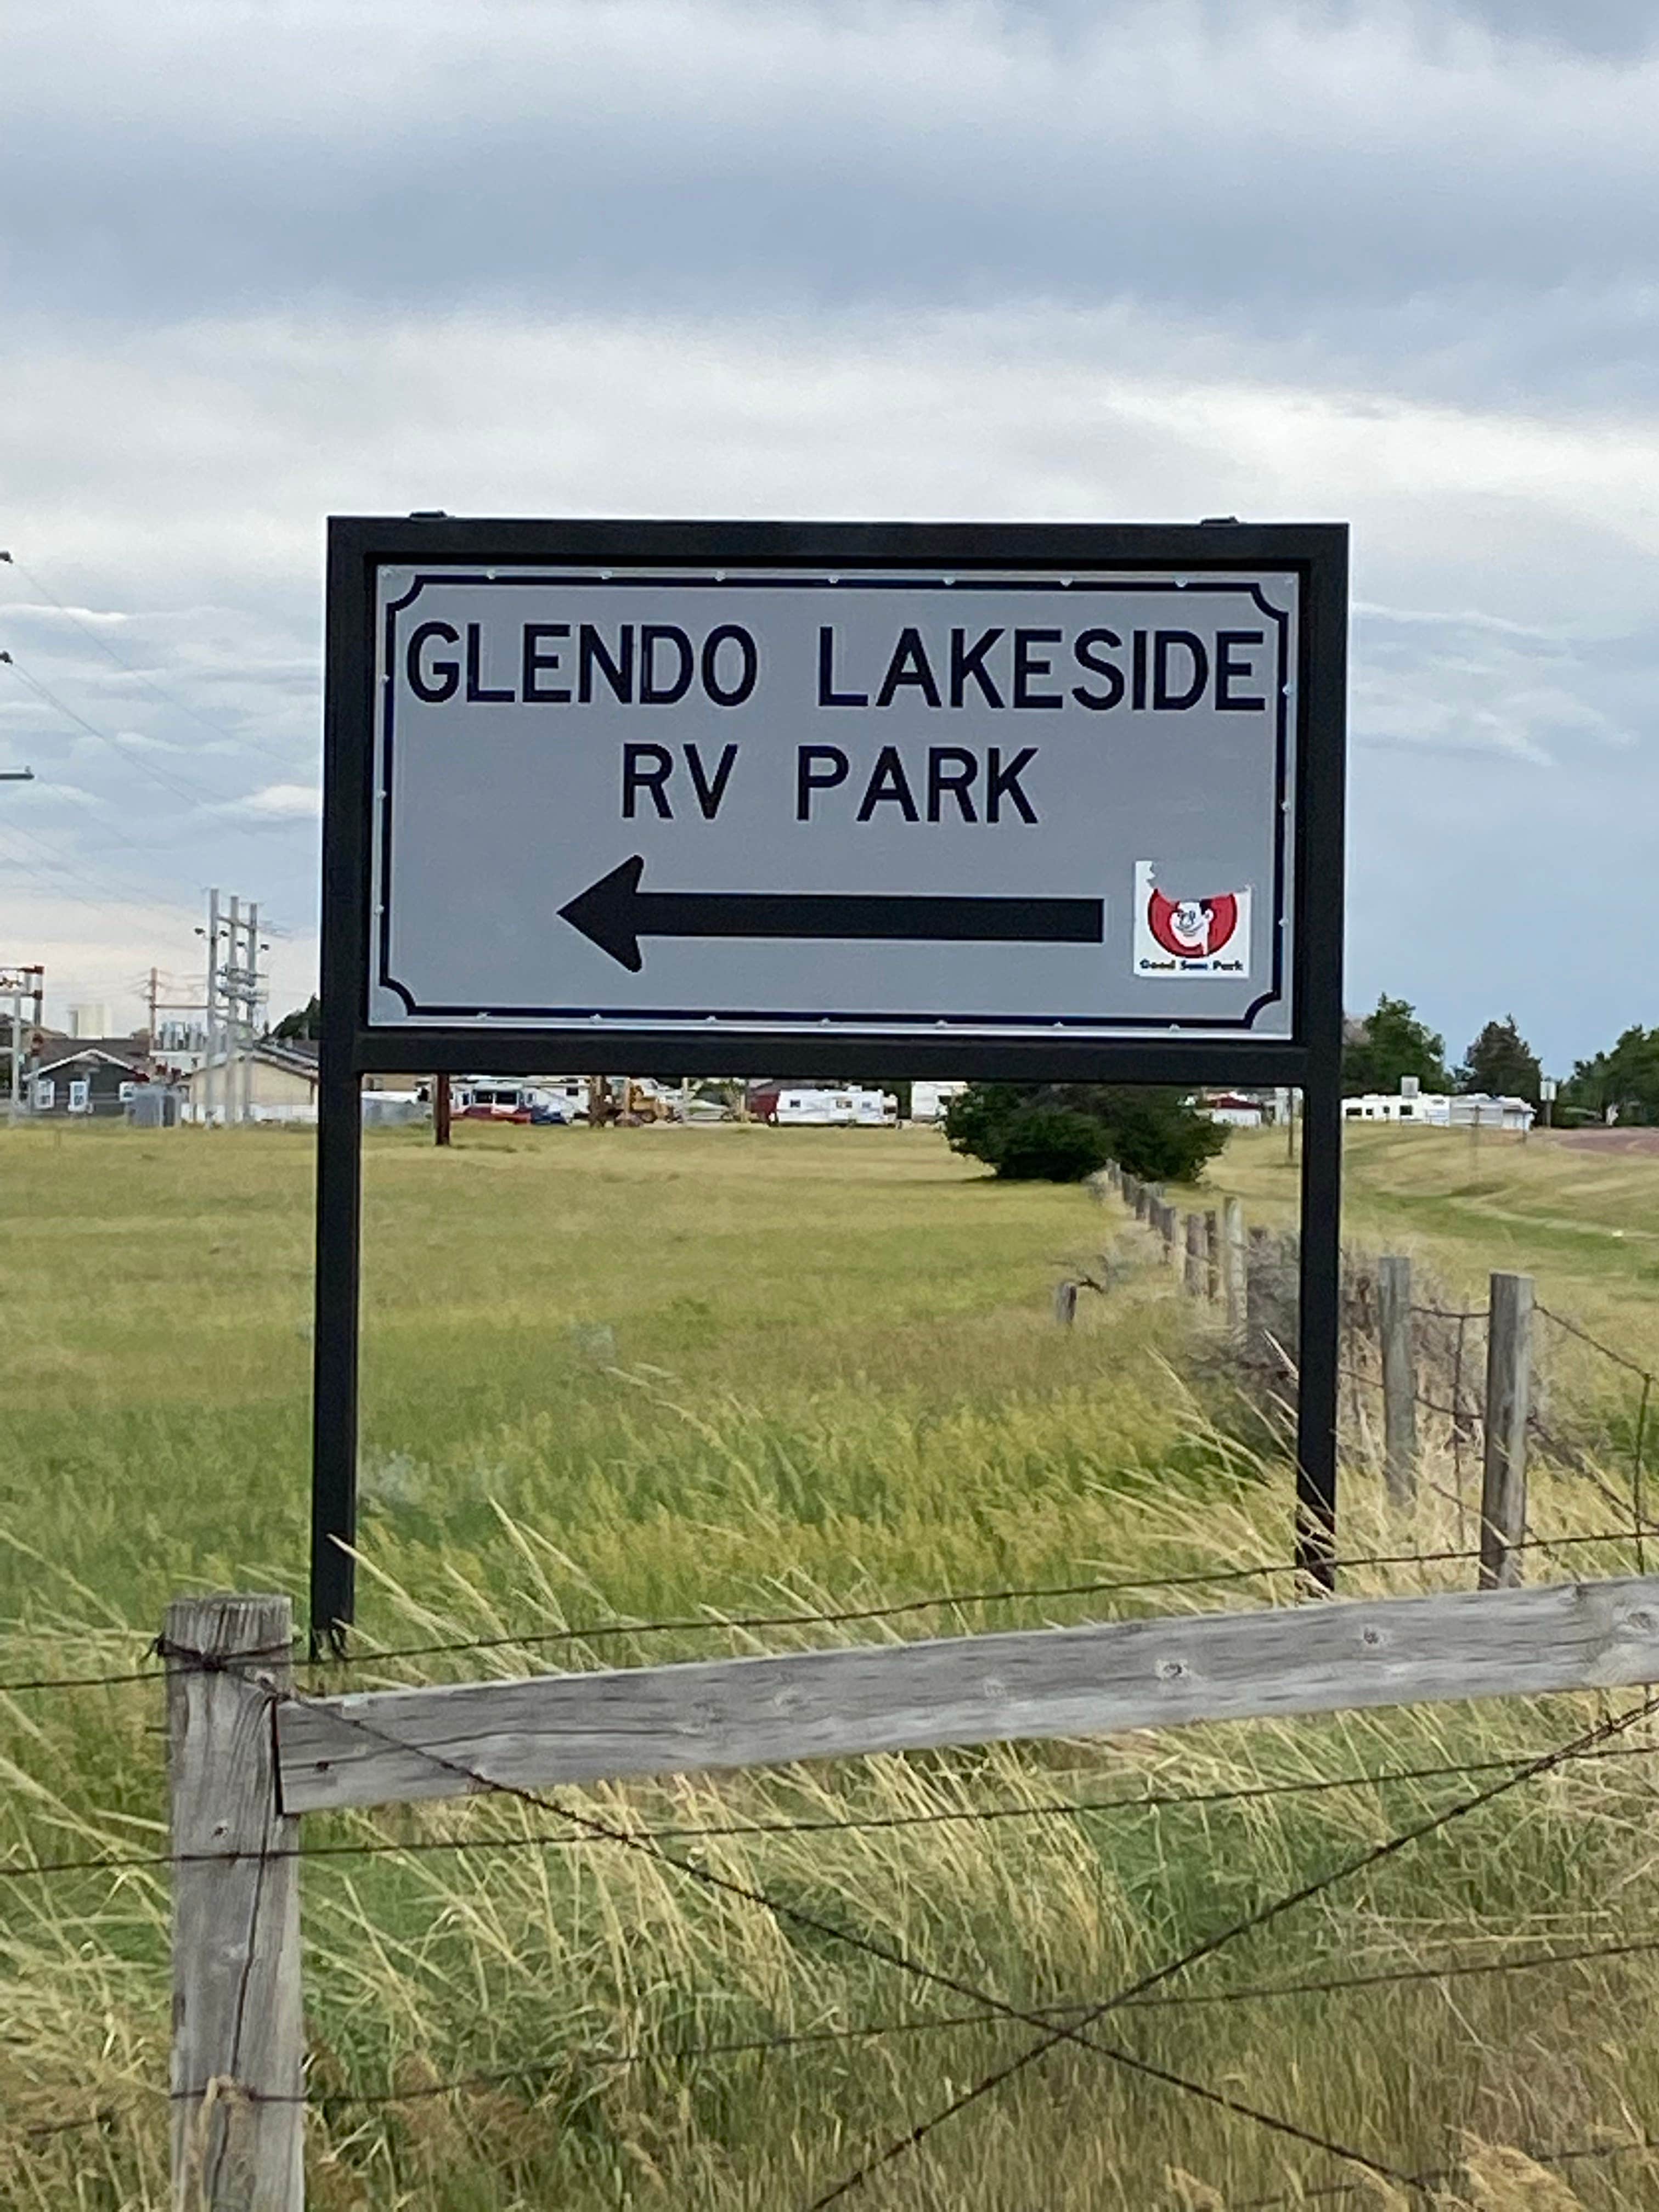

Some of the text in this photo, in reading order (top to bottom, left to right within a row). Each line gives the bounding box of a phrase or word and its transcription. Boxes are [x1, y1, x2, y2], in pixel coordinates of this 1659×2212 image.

[406, 620, 1266, 712] GLENDO LAKESIDE
[621, 742, 1039, 825] RV PARK
